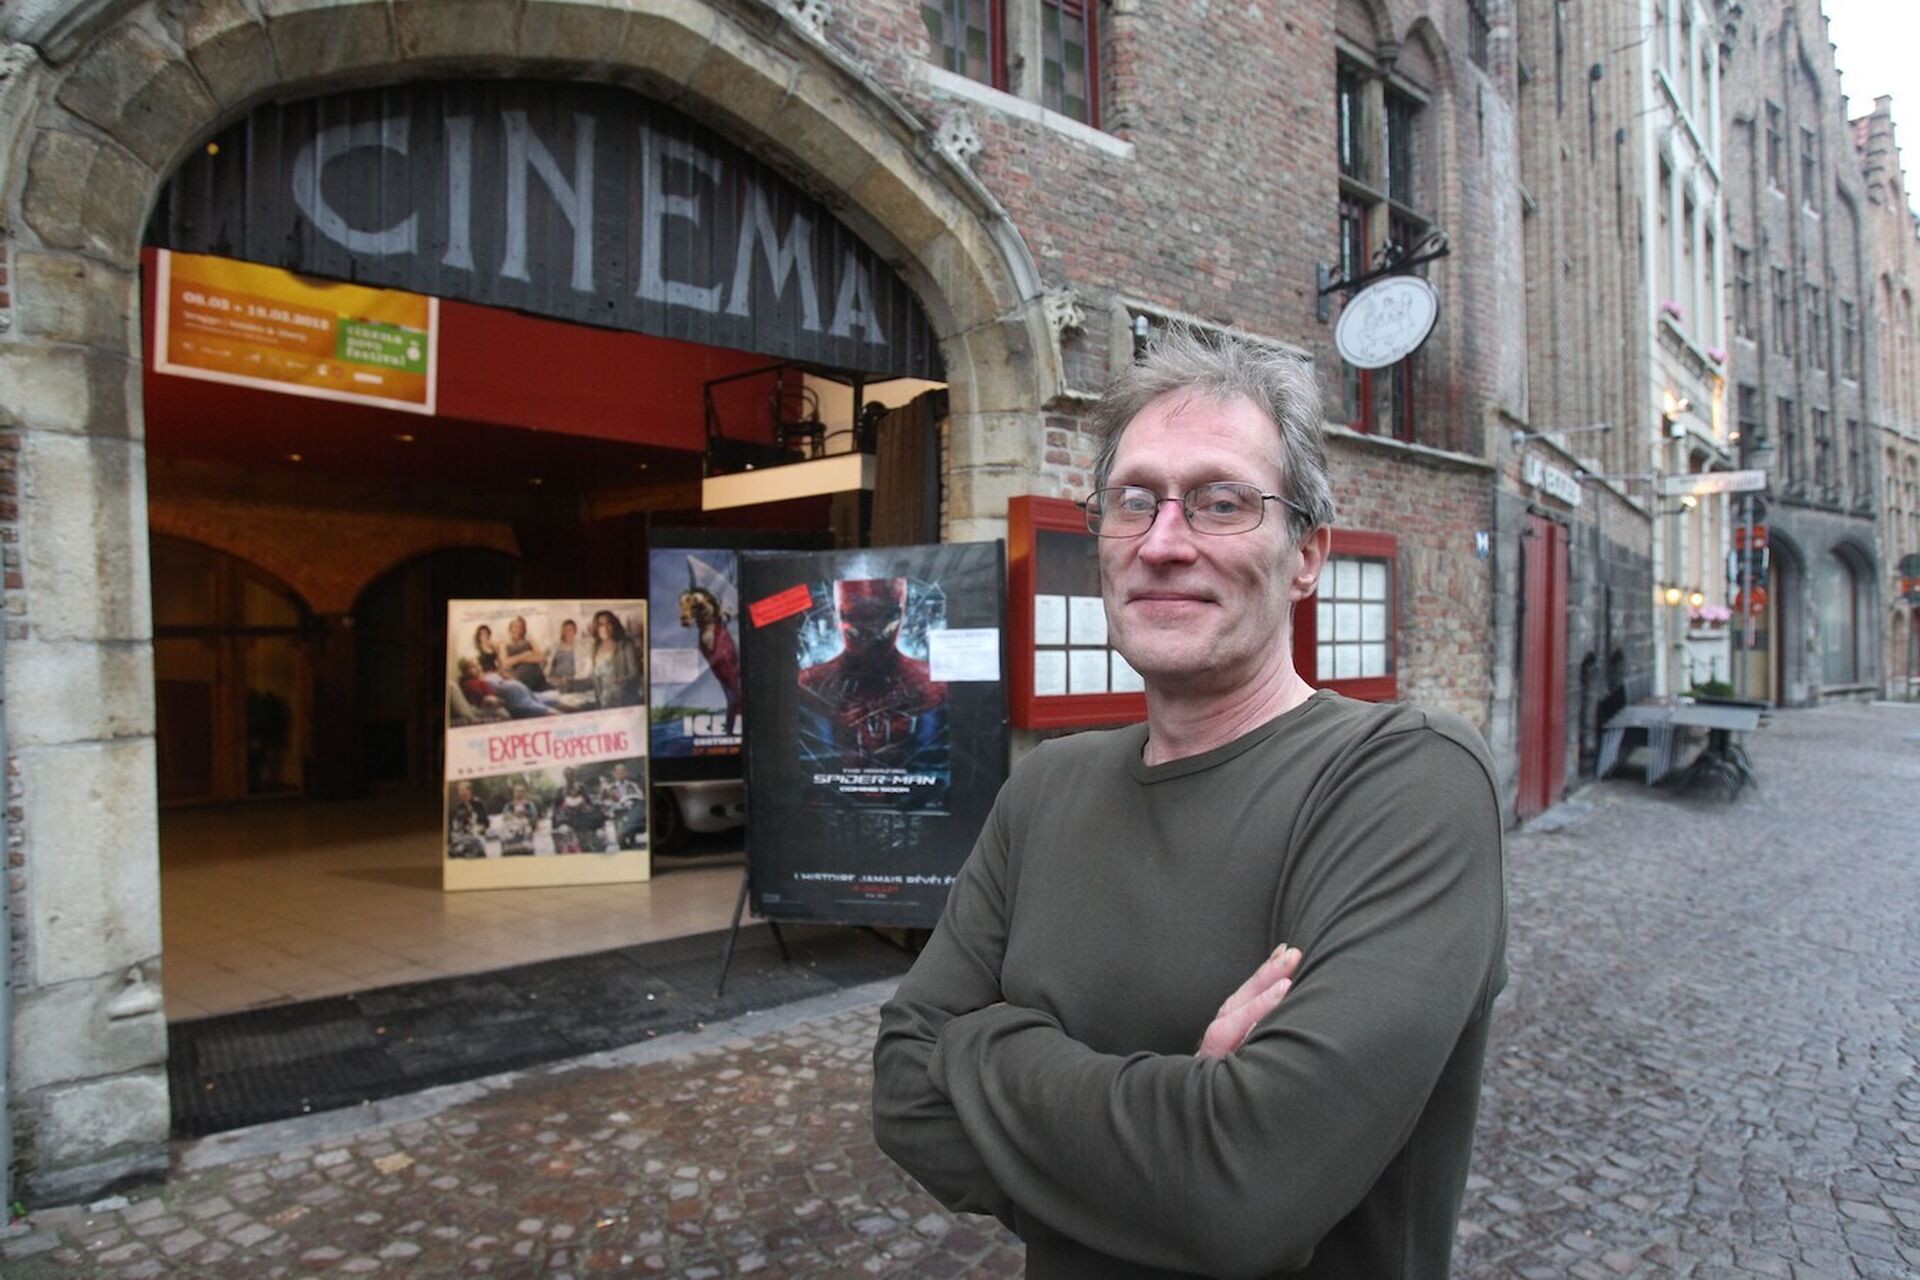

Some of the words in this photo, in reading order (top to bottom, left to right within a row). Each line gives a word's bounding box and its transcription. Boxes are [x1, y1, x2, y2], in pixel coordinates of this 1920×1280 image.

[291, 110, 886, 345] CINEMA
[683, 713, 727, 737] ICE
[488, 730, 552, 763] EXPECT
[553, 731, 629, 760] EXPECTING
[813, 773, 936, 785] SPIDER-MAN
